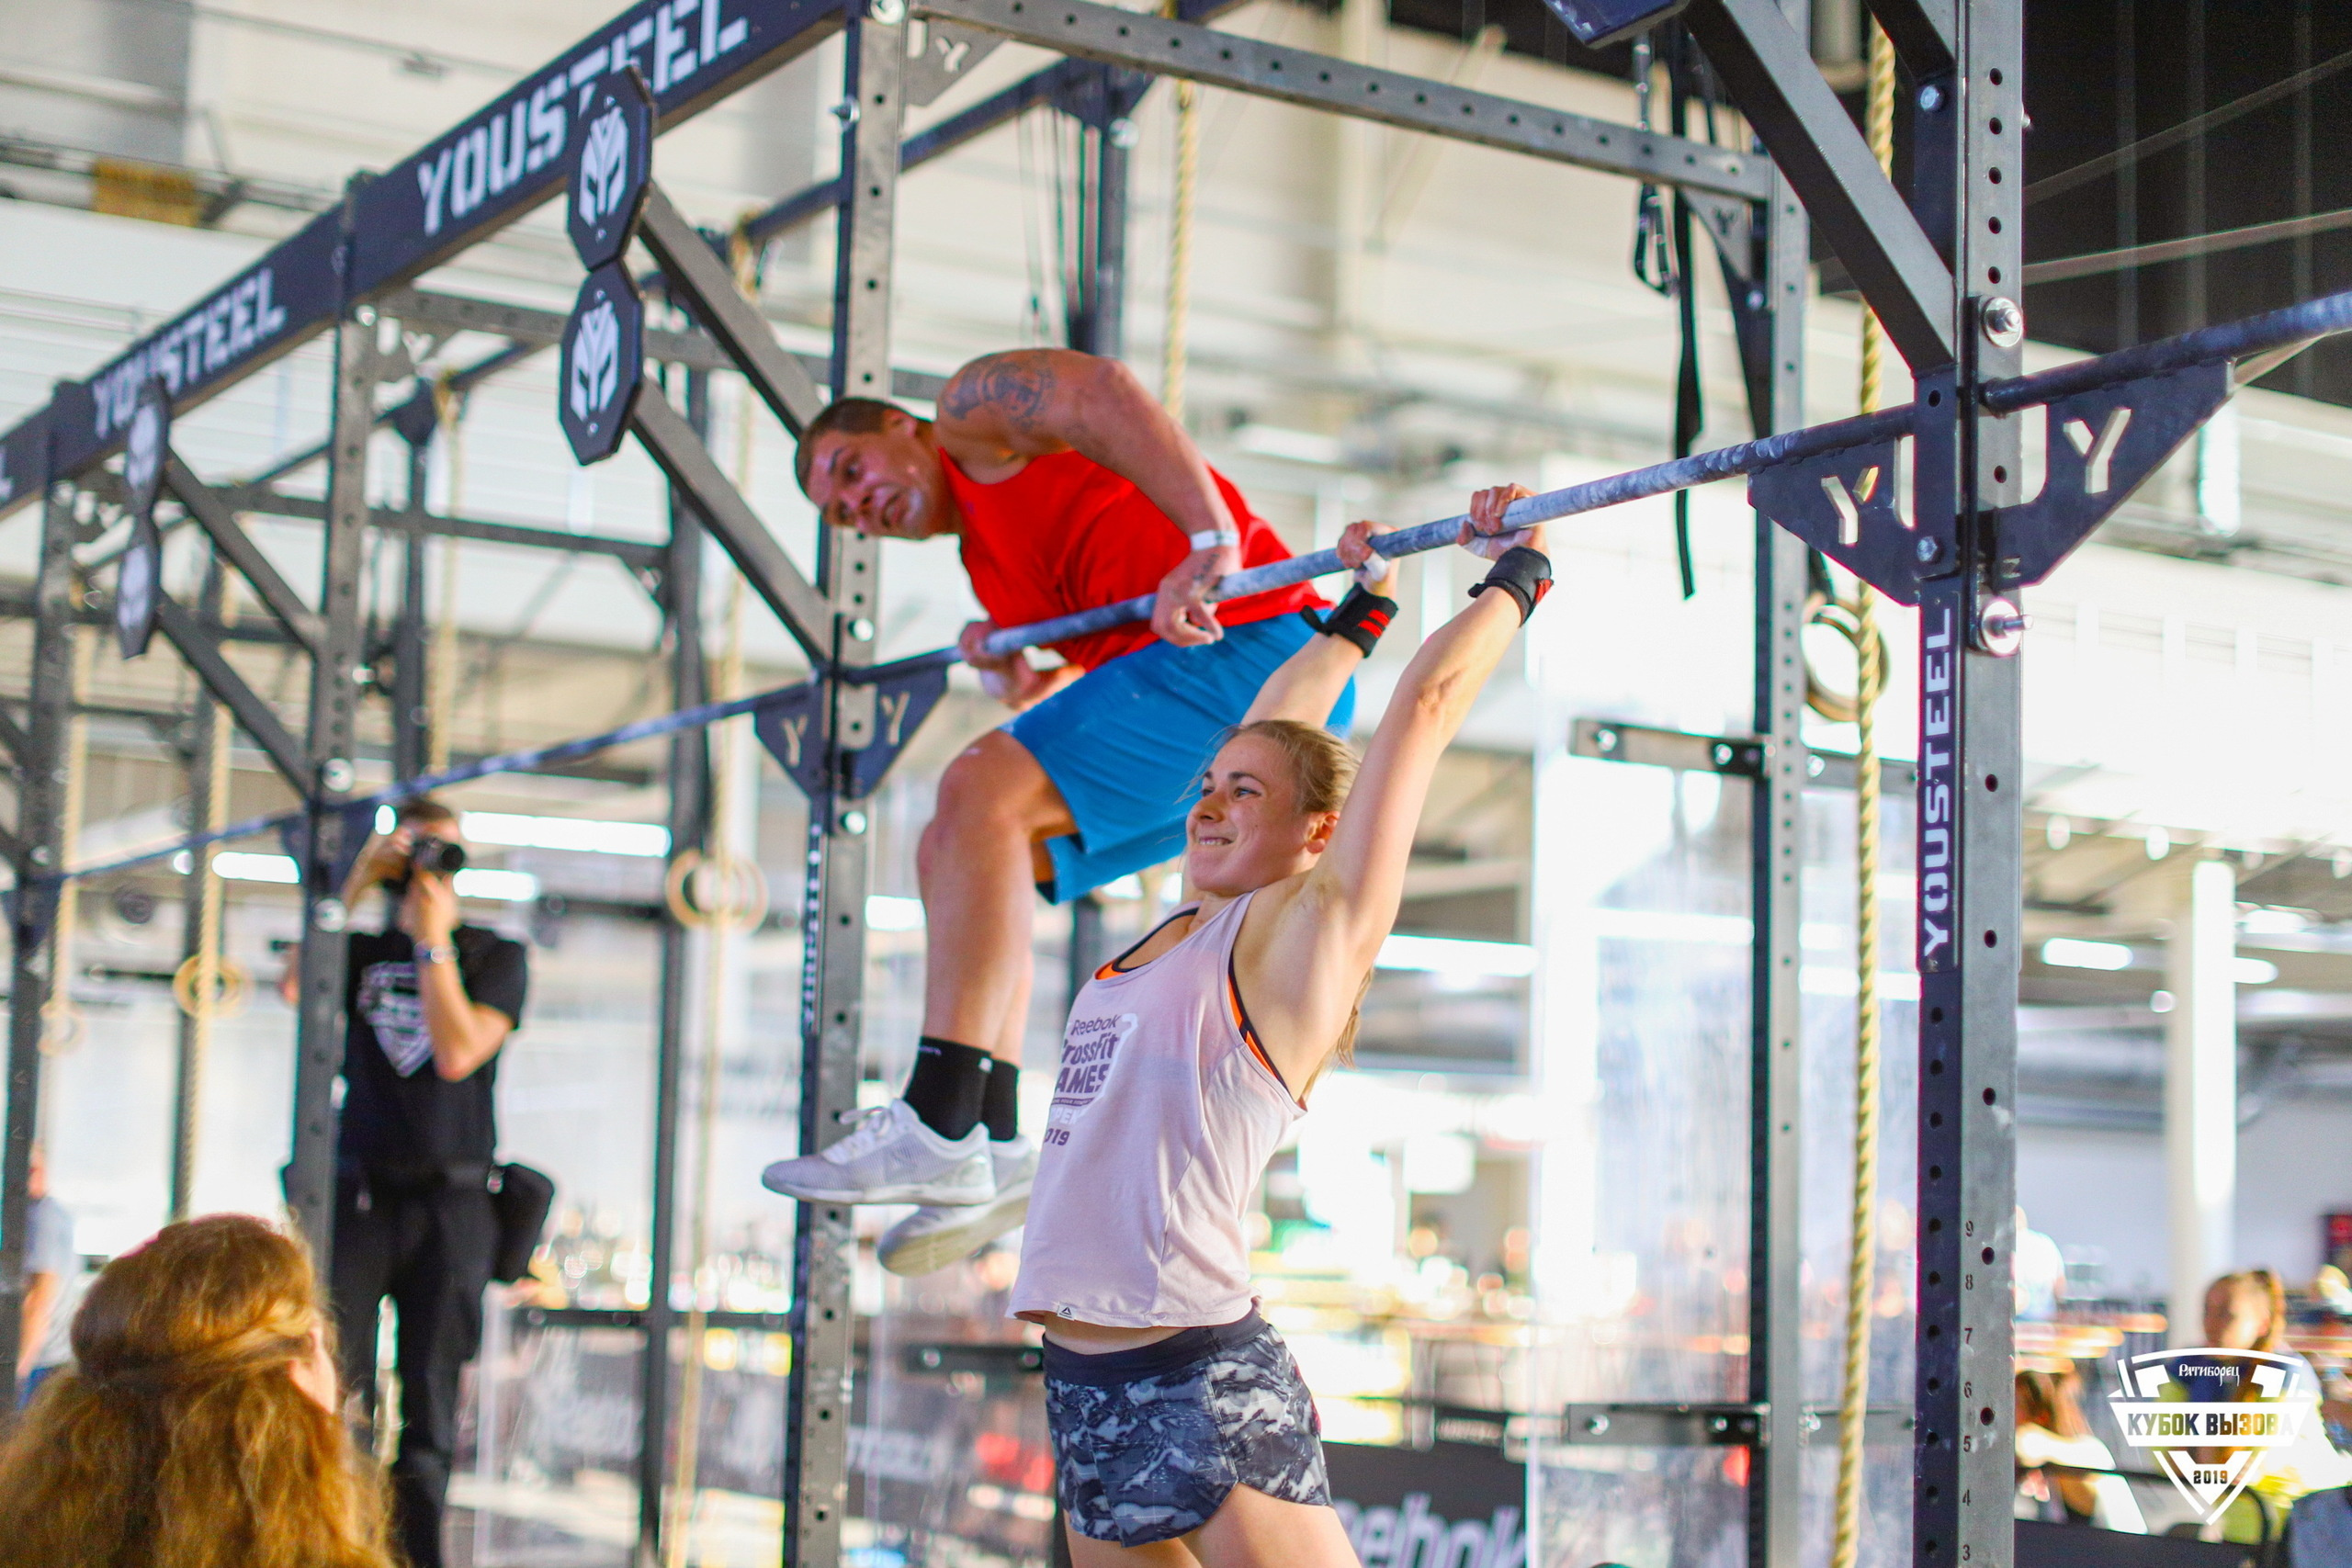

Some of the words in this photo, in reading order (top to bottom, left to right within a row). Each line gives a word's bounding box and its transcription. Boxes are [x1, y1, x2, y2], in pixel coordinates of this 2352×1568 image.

[1924, 607, 1951, 957] YOUSTEEL
[1070, 1014, 1121, 1036] Reebok
[1061, 1032, 1119, 1066] rossFit
[1056, 1063, 1110, 1094] AMES
[1965, 1221, 1973, 1237] 9
[1964, 1274, 1973, 1291] 8
[1964, 1328, 1973, 1345] 7
[1964, 1382, 1972, 1398] 6
[1963, 1436, 1972, 1453] 5
[1962, 1489, 1971, 1506] 4
[1962, 1544, 1971, 1562] 3
